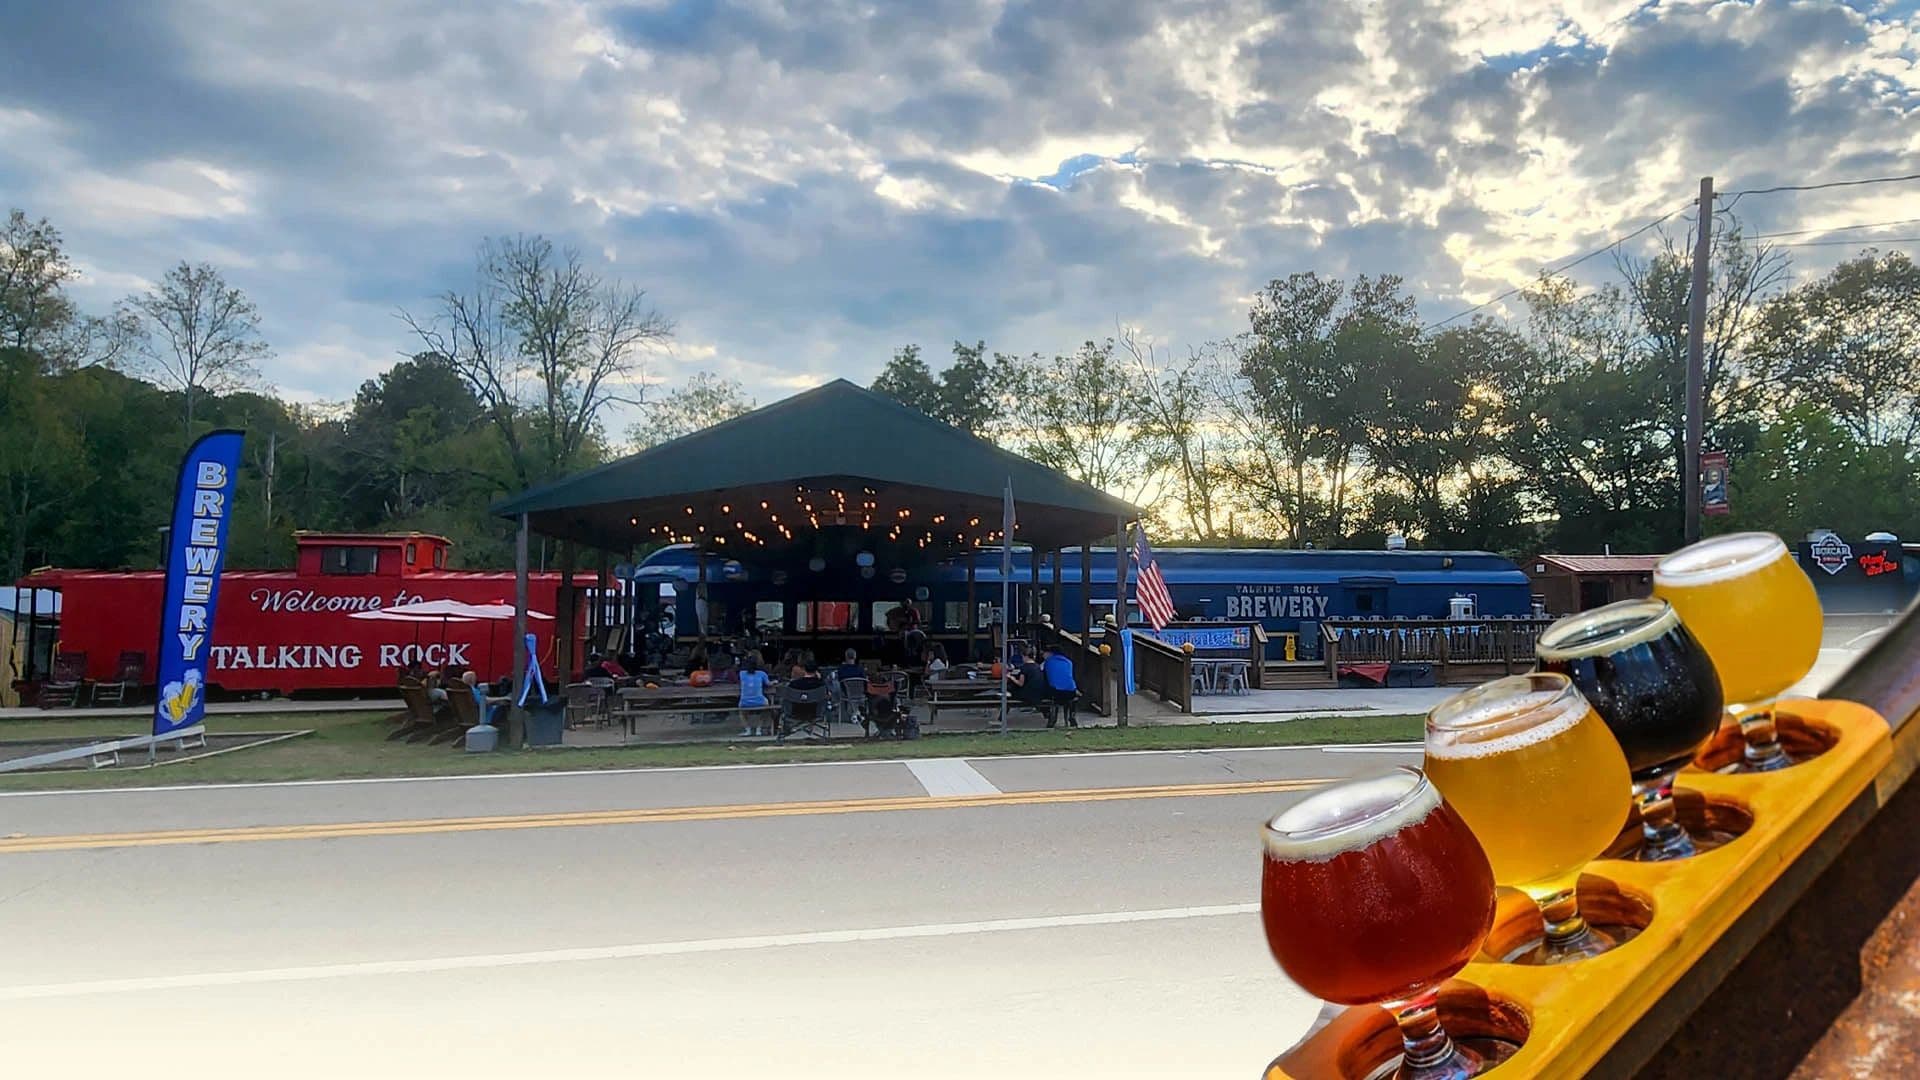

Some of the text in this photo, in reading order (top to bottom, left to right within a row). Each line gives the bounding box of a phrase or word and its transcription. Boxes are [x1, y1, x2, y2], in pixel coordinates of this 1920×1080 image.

[178, 461, 227, 661] BREWERY
[251, 588, 424, 612] Welcome to
[1236, 586, 1320, 594] TALKING ROCK
[1226, 596, 1328, 617] BREWERY
[210, 644, 471, 670] TALKING ROCK
